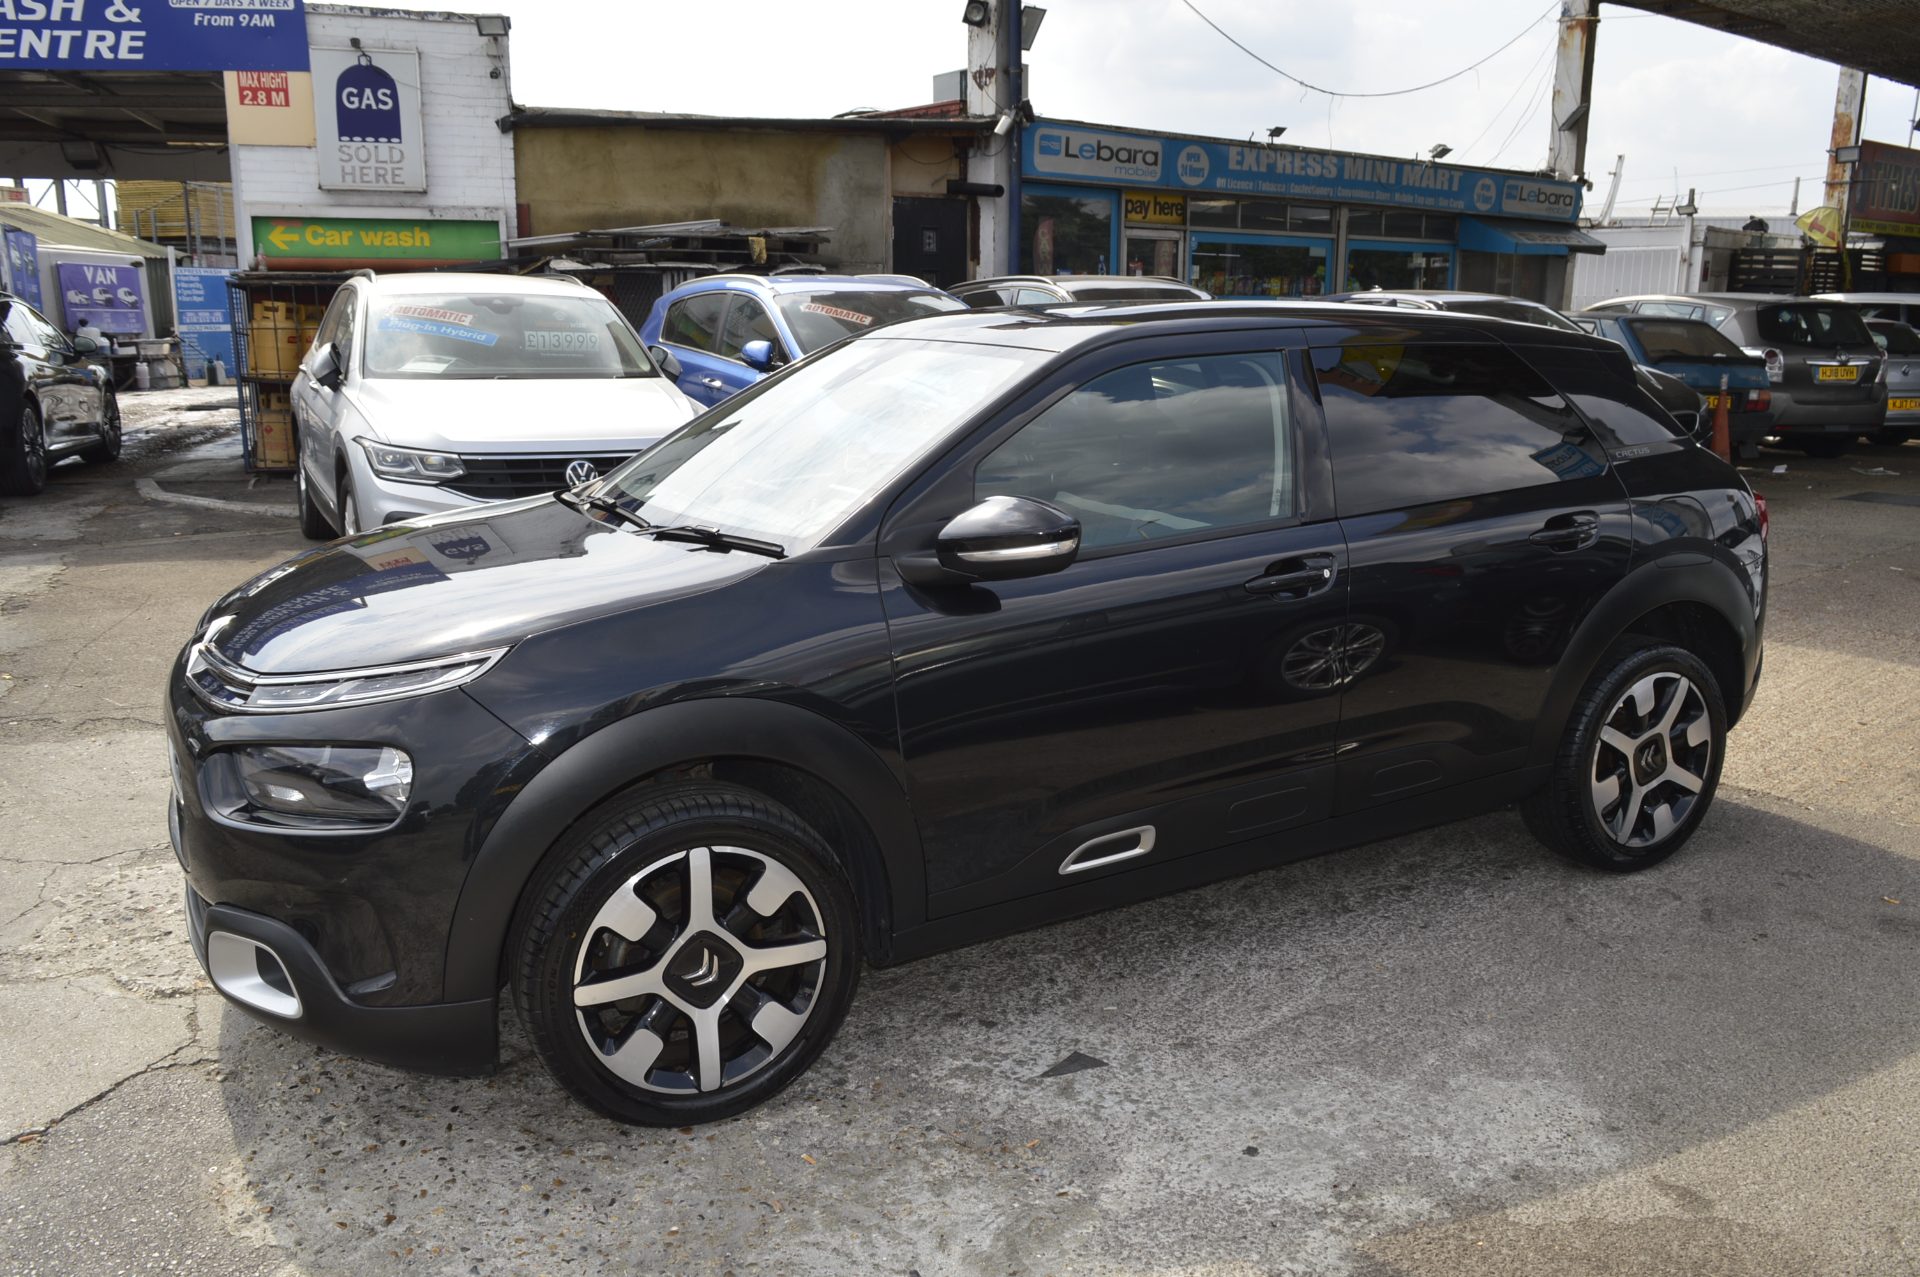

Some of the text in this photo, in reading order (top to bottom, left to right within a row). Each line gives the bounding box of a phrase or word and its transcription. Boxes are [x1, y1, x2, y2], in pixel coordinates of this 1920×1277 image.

[104, 0, 143, 23] &
[194, 13, 276, 28] From 9AM
[0, 28, 147, 60] ENTRE
[239, 71, 287, 89] MAX HIGHT
[243, 91, 286, 106] 2.8 M
[341, 87, 394, 111] GAS
[338, 144, 405, 164] SOLD
[1064, 136, 1159, 167] Lebara
[341, 165, 405, 185] HERE
[1113, 165, 1158, 178] mobile
[1228, 145, 1463, 191] EXPRESS MINI MART
[1518, 185, 1574, 207] Lebara
[1125, 196, 1185, 219] pay here
[305, 225, 432, 247] Car wash
[83, 266, 118, 285] VAN
[394, 305, 469, 323] AUTOMATIC
[805, 304, 868, 323] AUTOMATIC
[389, 318, 486, 341] Plug-in Hybrid
[527, 333, 598, 349] £13999
[1616, 446, 1650, 458] CACTUS
